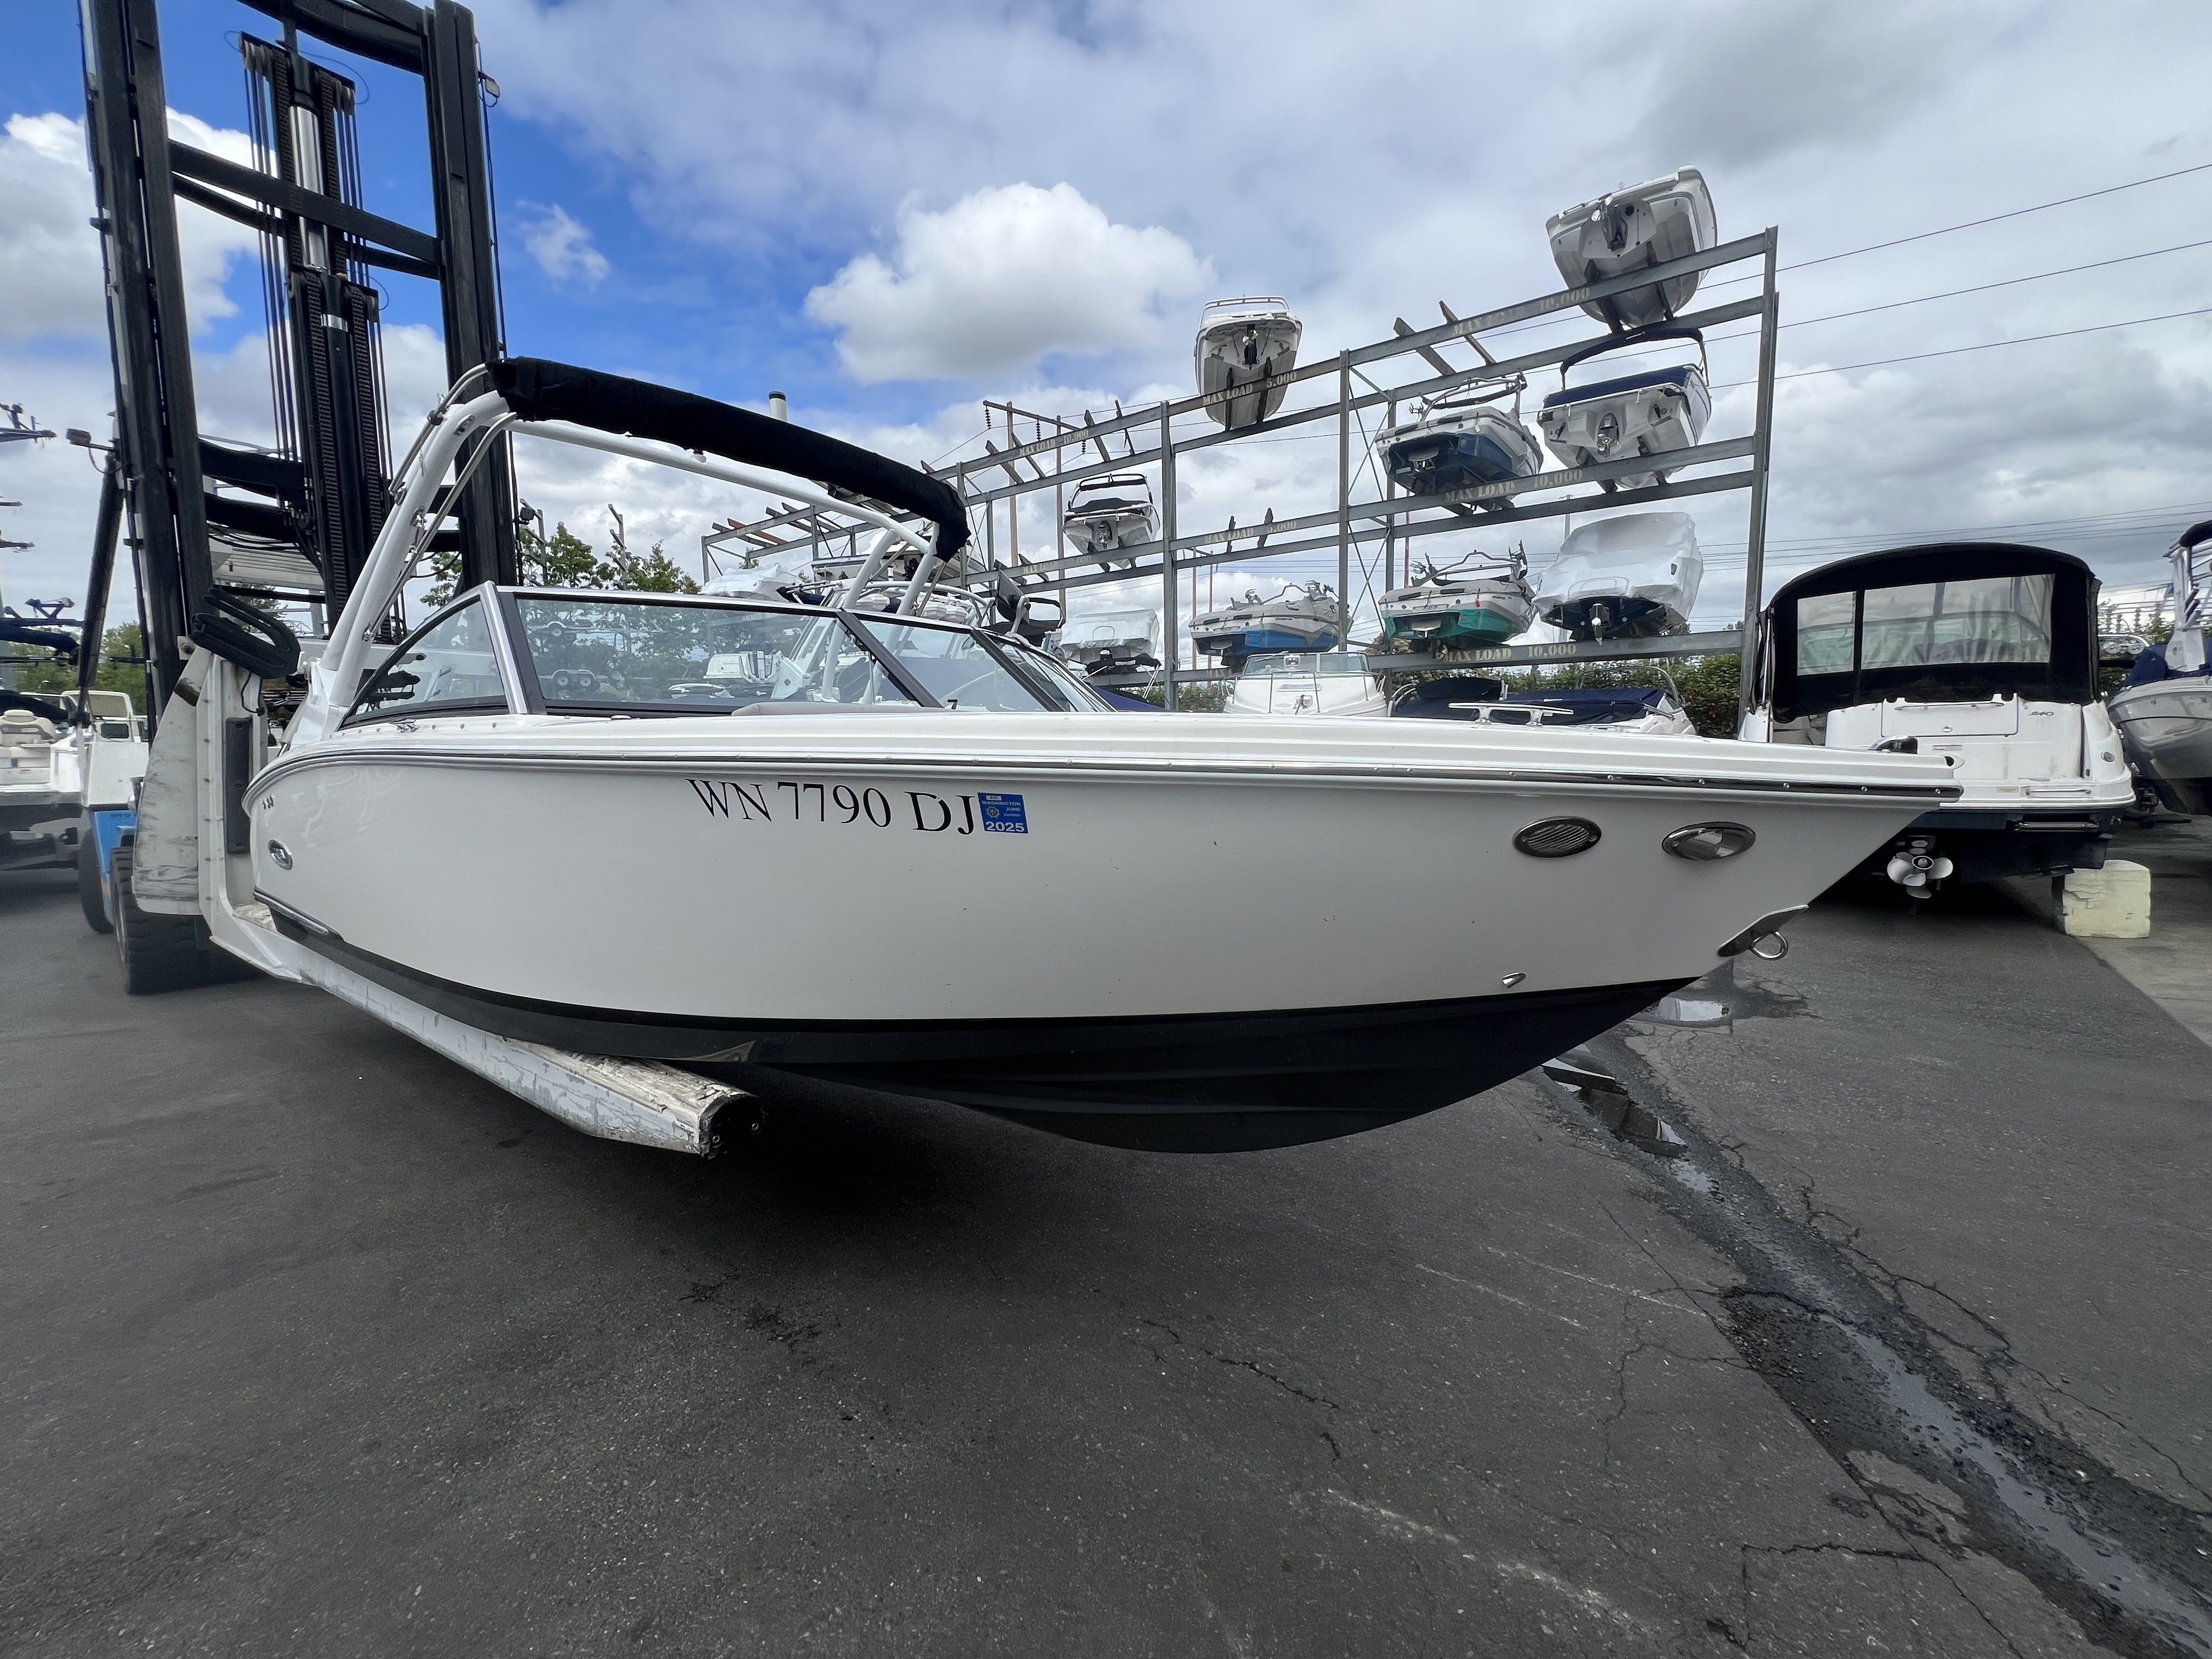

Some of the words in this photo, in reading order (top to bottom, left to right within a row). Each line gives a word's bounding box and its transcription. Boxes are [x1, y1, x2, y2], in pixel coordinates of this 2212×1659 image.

[1203, 391, 1224, 406] MAX
[1227, 383, 1253, 399] LOAD
[1019, 445, 1035, 456] MAX
[1036, 439, 1056, 450] LOAD
[1444, 487, 1474, 503] MAX
[1477, 481, 1516, 498] LOAD
[1204, 533, 1225, 545] MAX
[1228, 528, 1254, 540] LOAD
[1443, 651, 1471, 663] MAX
[1475, 648, 1512, 661] LOAD
[1528, 644, 1577, 657] 10,000
[685, 778, 772, 822] WN
[777, 781, 891, 828] 7790
[904, 791, 975, 835] DJ
[985, 821, 1024, 832] 2025
